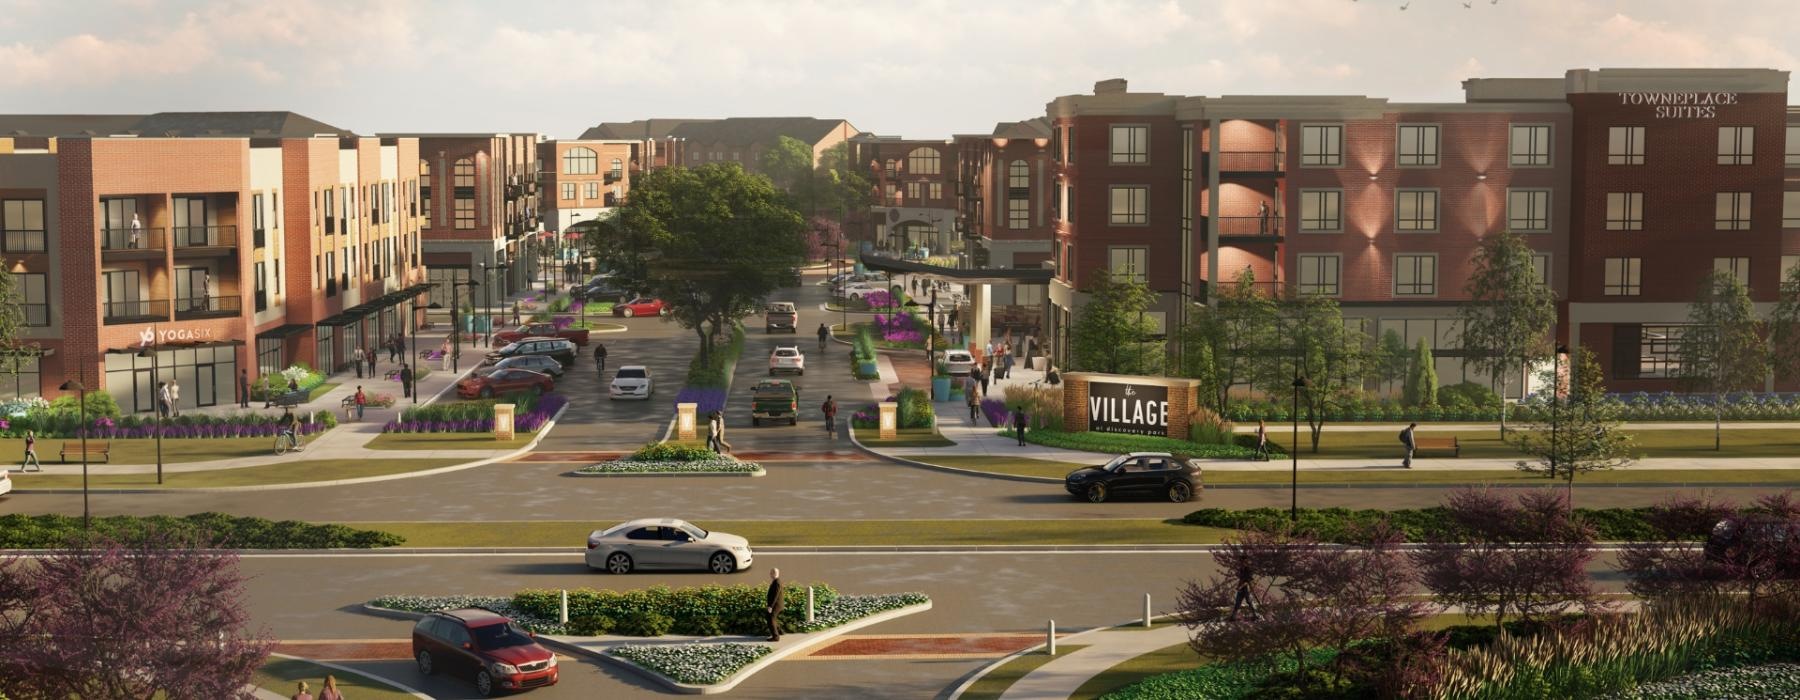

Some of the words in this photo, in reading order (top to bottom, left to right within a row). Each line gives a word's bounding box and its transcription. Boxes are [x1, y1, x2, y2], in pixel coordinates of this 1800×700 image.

[1618, 92, 1738, 105] TOWNEPLACE
[1655, 105, 1716, 118] SUITES
[159, 328, 211, 341] YOGASIX
[1090, 396, 1168, 426] VILLAGE
